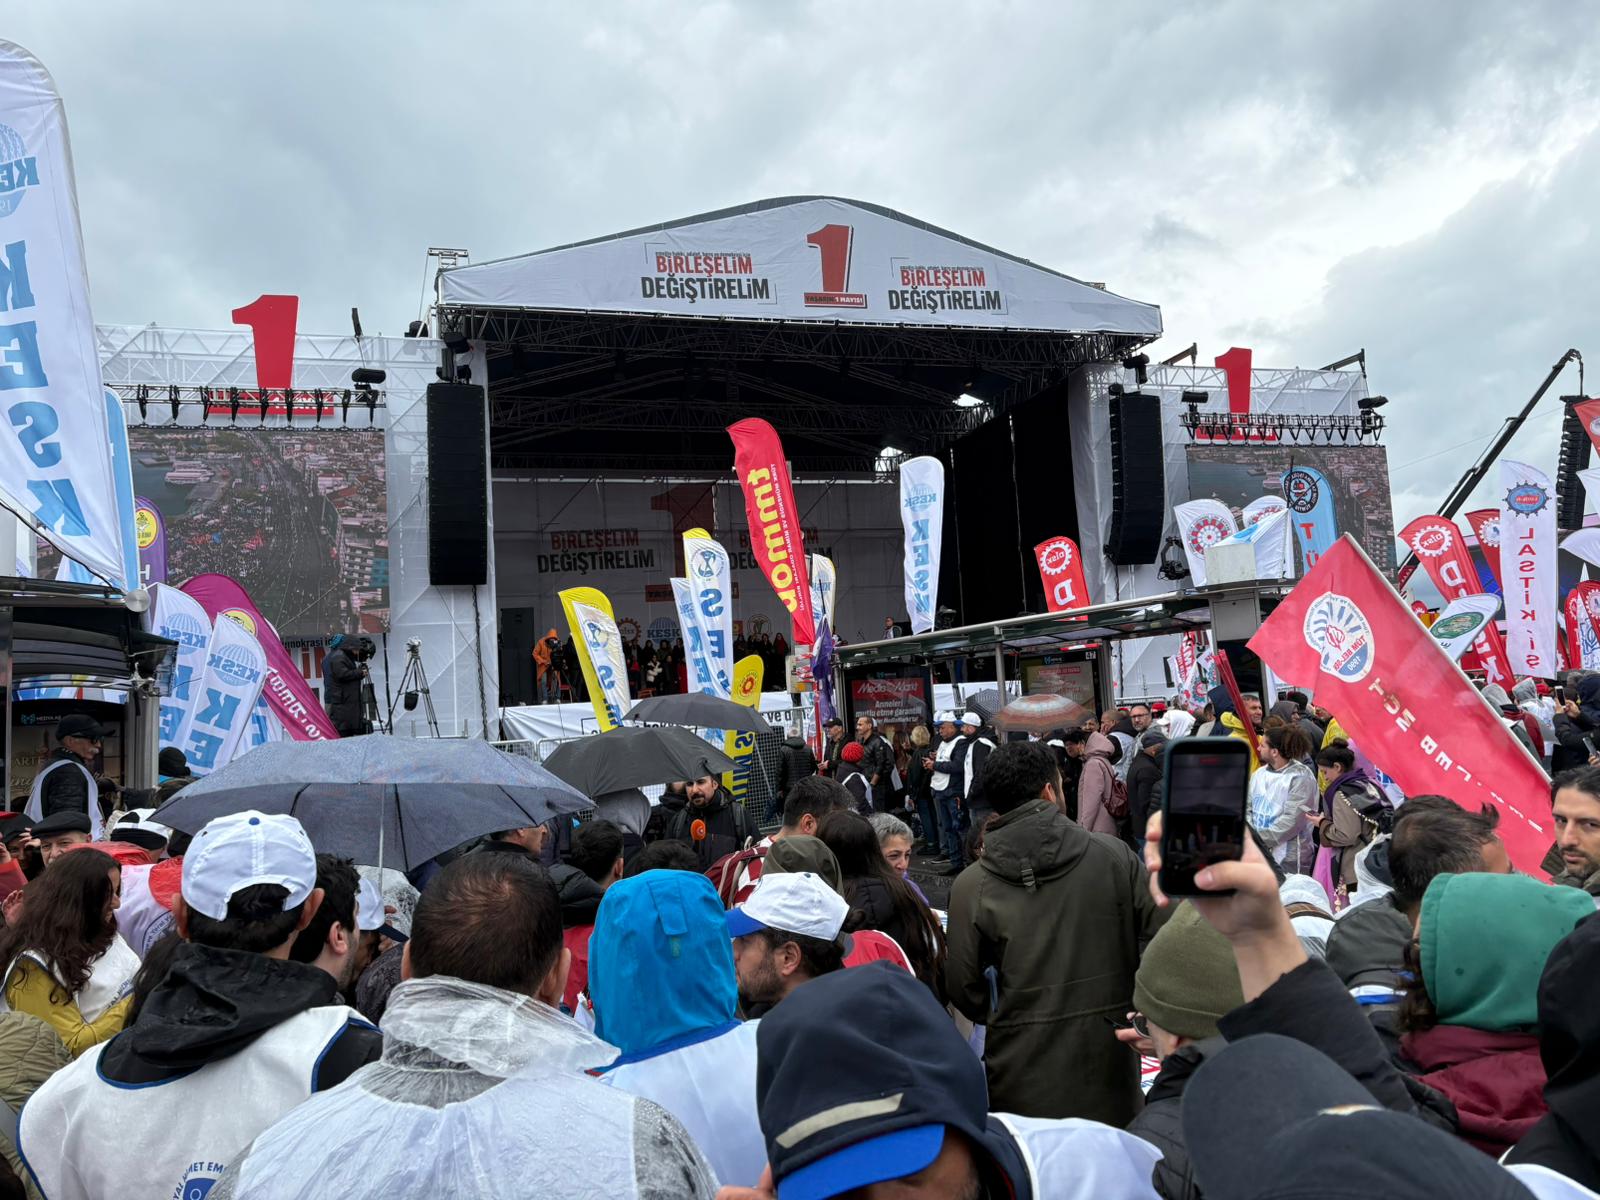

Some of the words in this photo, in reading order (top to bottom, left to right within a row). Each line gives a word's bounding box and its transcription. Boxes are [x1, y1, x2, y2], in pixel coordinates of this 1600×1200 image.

[641, 273, 770, 304] DEĞİŞTİRELİM
[807, 224, 850, 291] 1
[888, 286, 1002, 314] DEĞİŞTİRELİM
[232, 295, 299, 389] 1
[1215, 347, 1252, 420] 1
